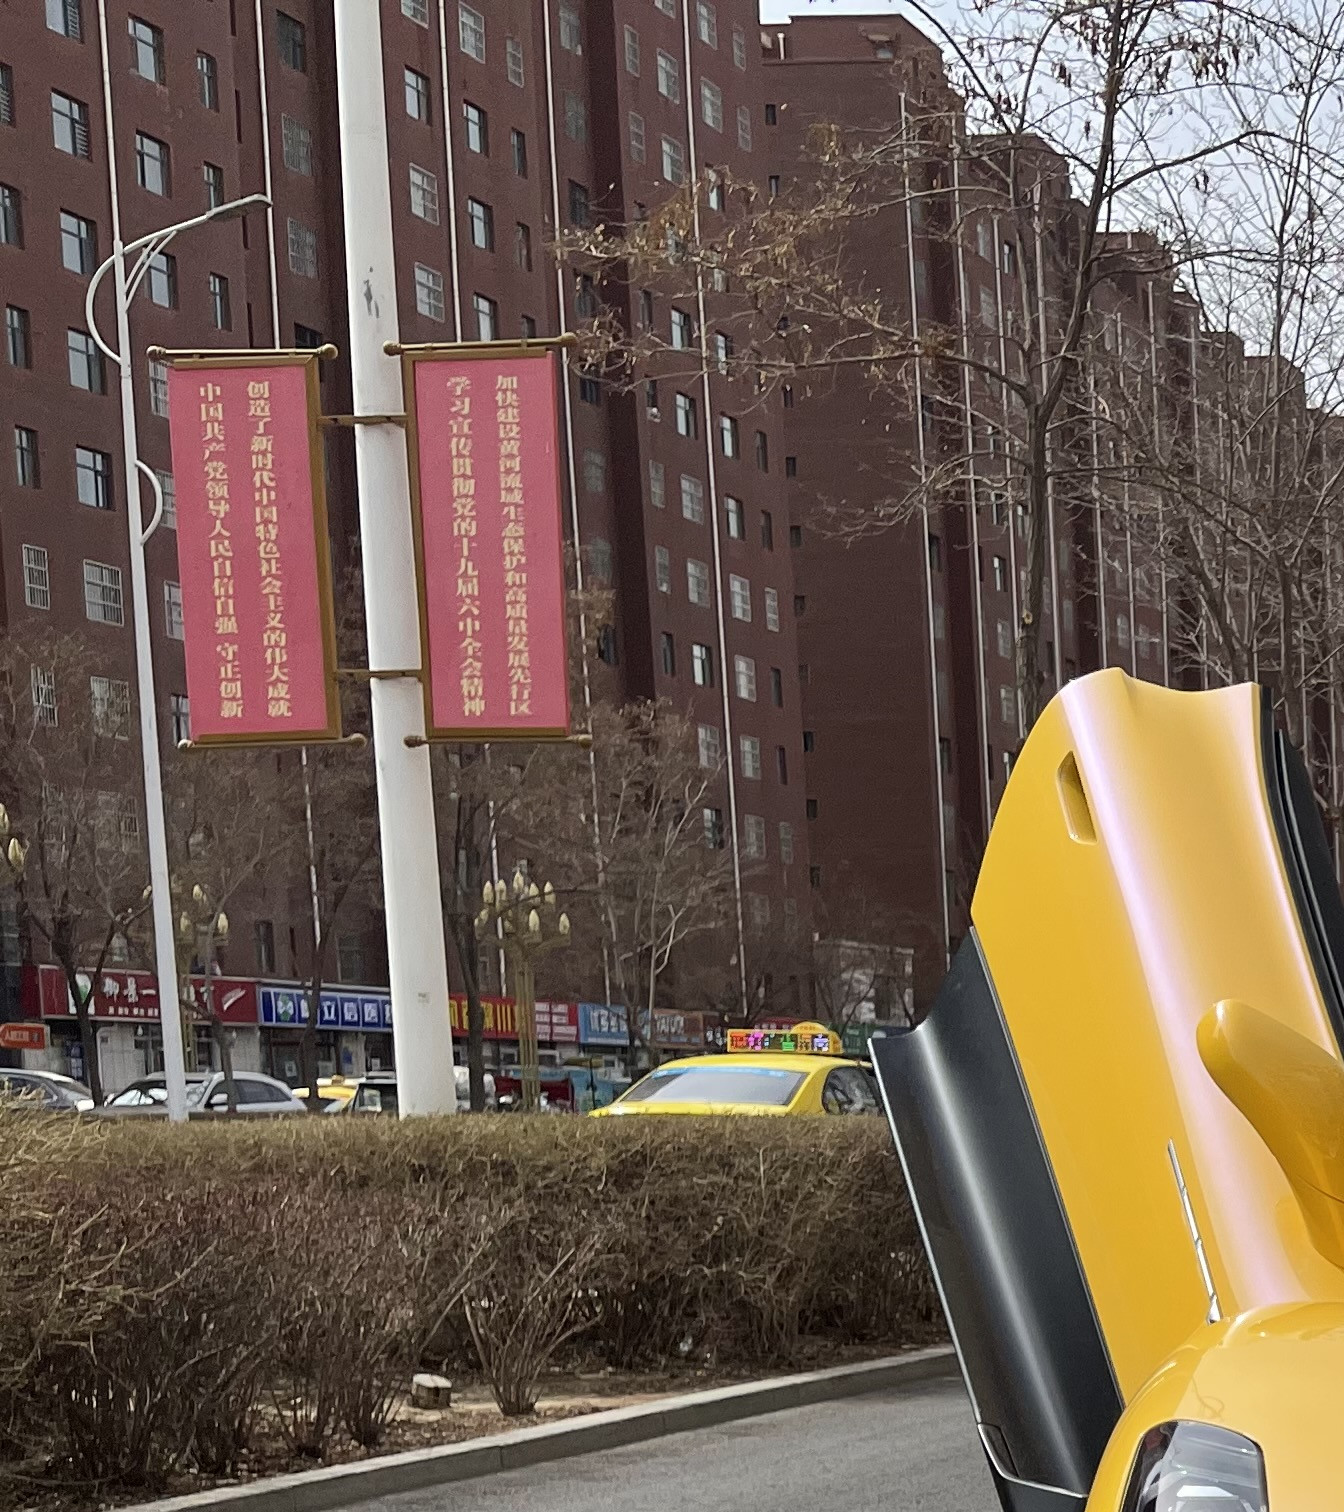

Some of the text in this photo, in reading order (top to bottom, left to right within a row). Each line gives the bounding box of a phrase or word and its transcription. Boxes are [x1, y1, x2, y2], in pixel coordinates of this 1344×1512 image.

[247, 380, 293, 718] 创造了新时代中国特色社会主义的伟大成就
[447, 375, 486, 717] 学习宣传贯彻党的十九届六中全会精神
[495, 375, 533, 716] 加快建设黄河流域生态保护和高质量发展先行区
